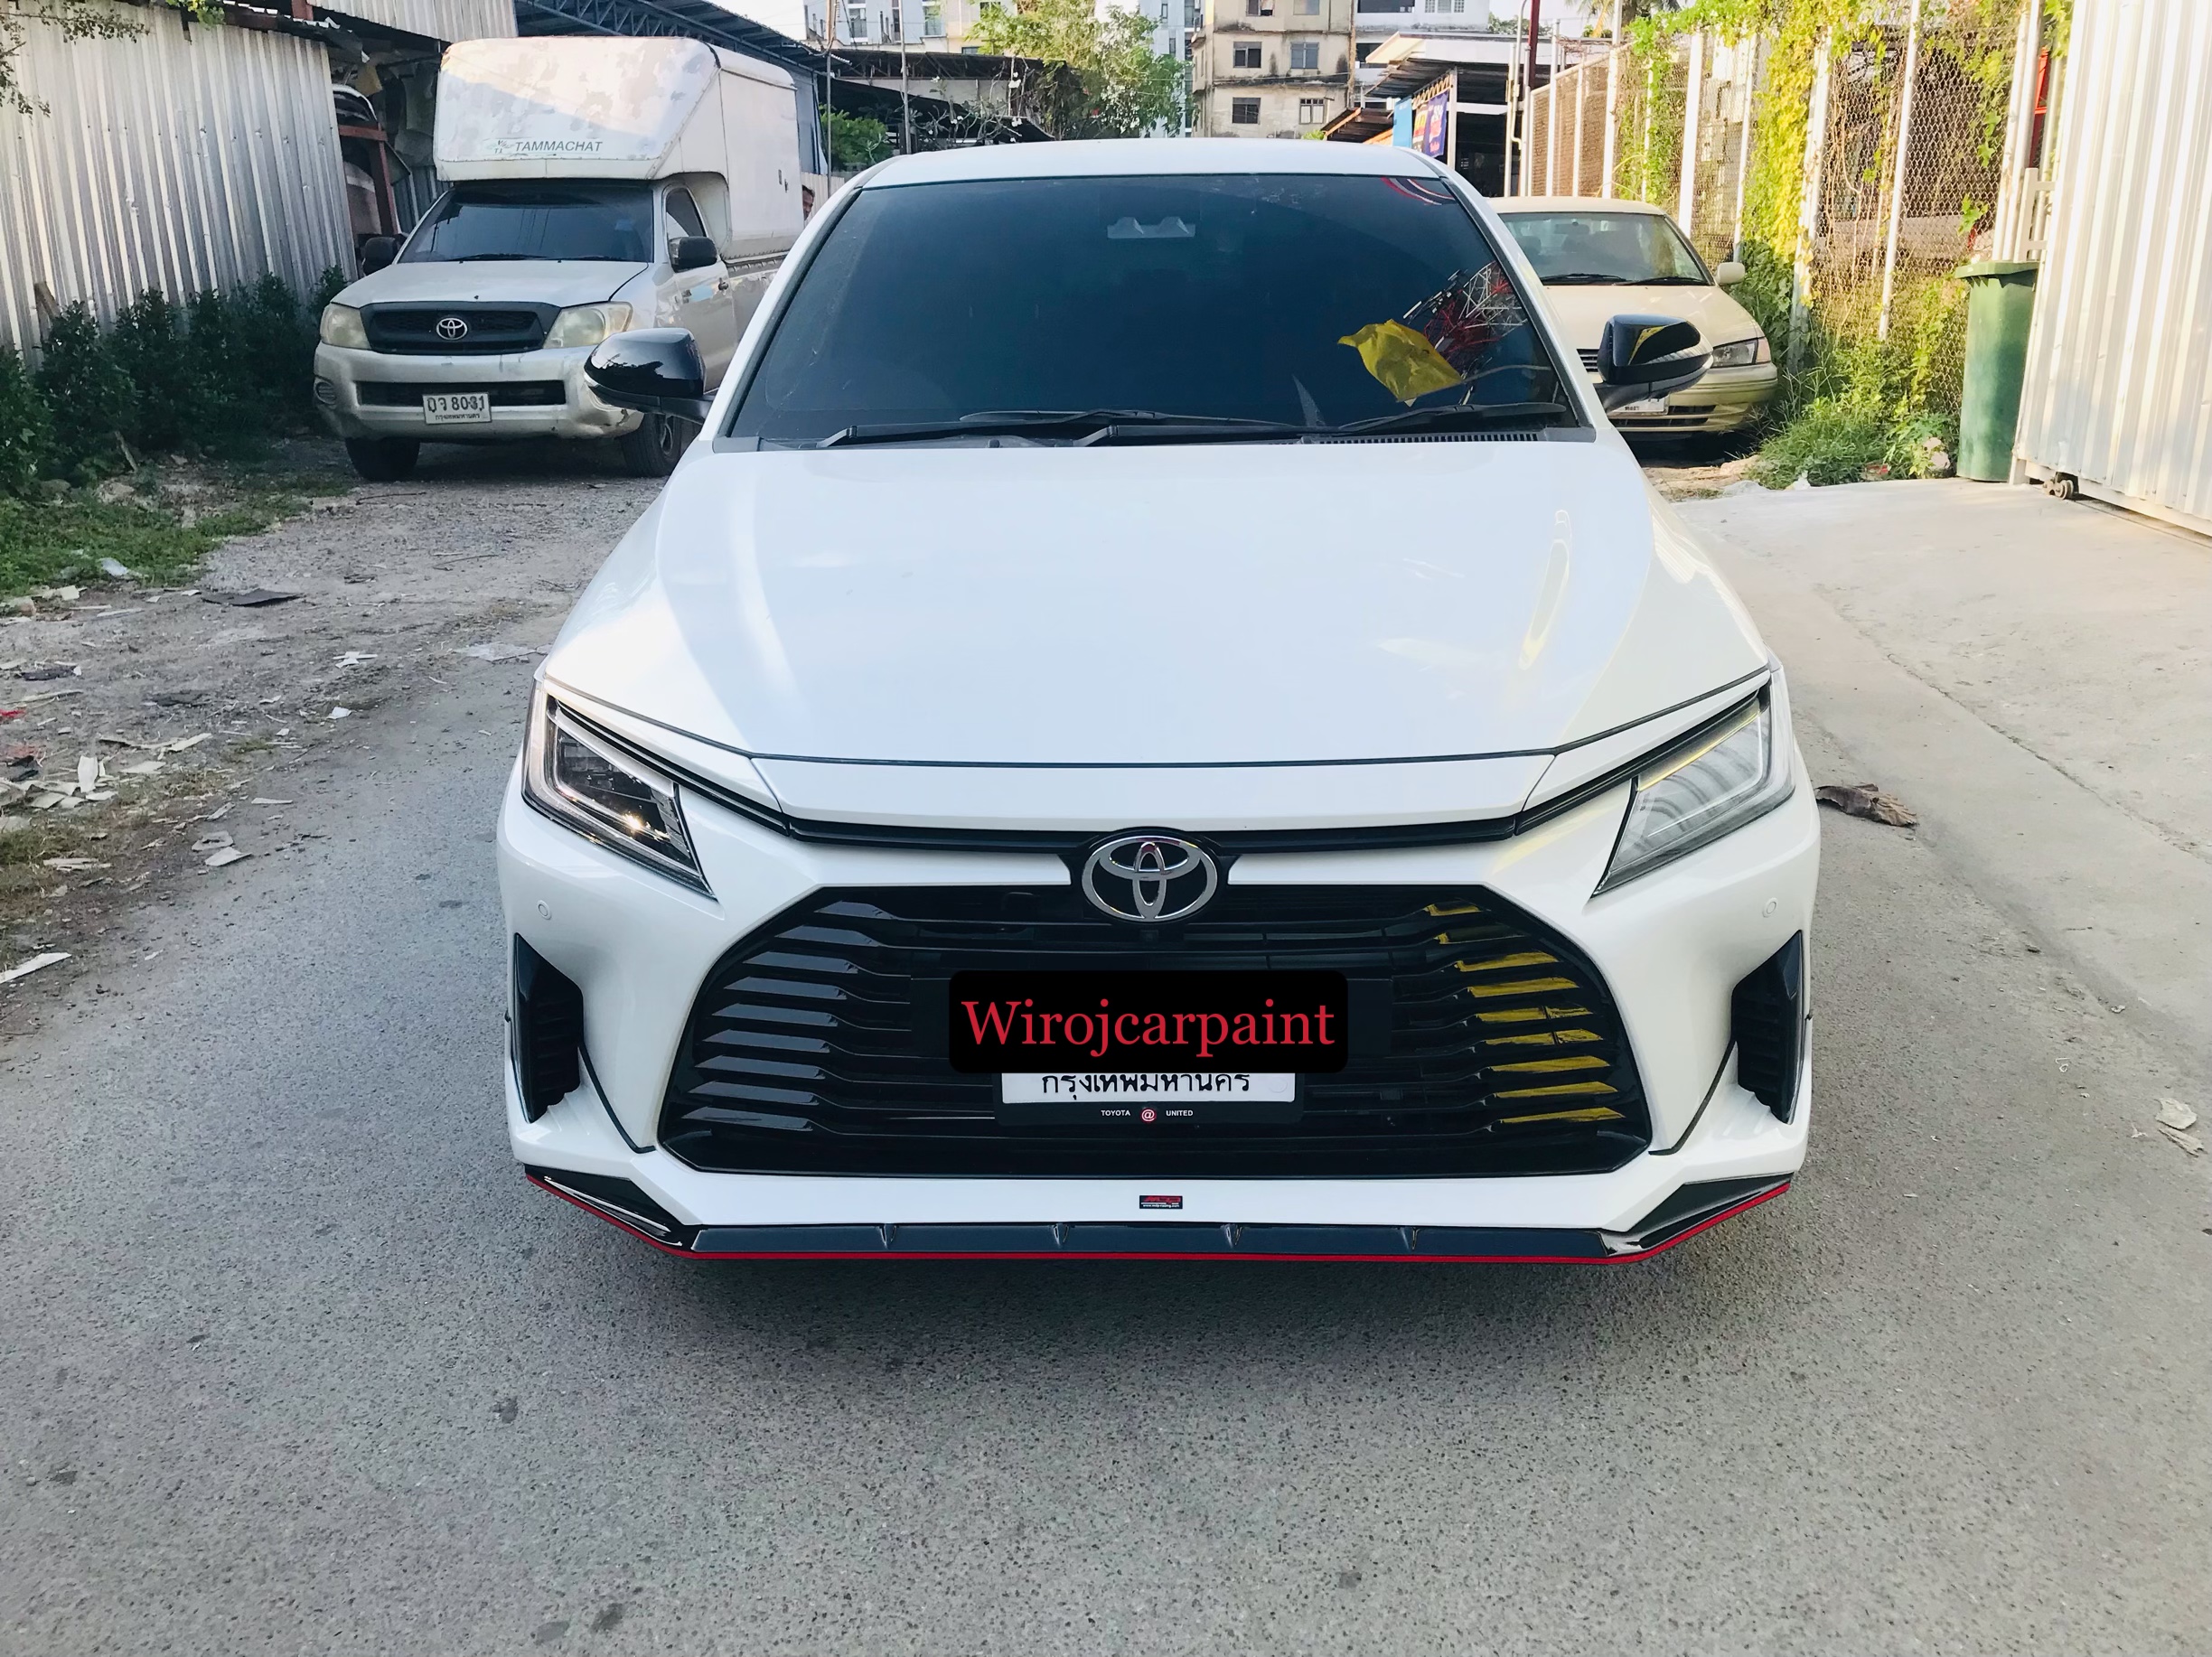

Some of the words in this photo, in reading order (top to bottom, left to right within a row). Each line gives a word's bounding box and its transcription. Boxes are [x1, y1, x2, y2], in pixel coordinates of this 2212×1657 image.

[515, 141, 603, 152] TAMMACHAT
[1041, 1073, 1250, 1100] กรุงเทพมหานคร
